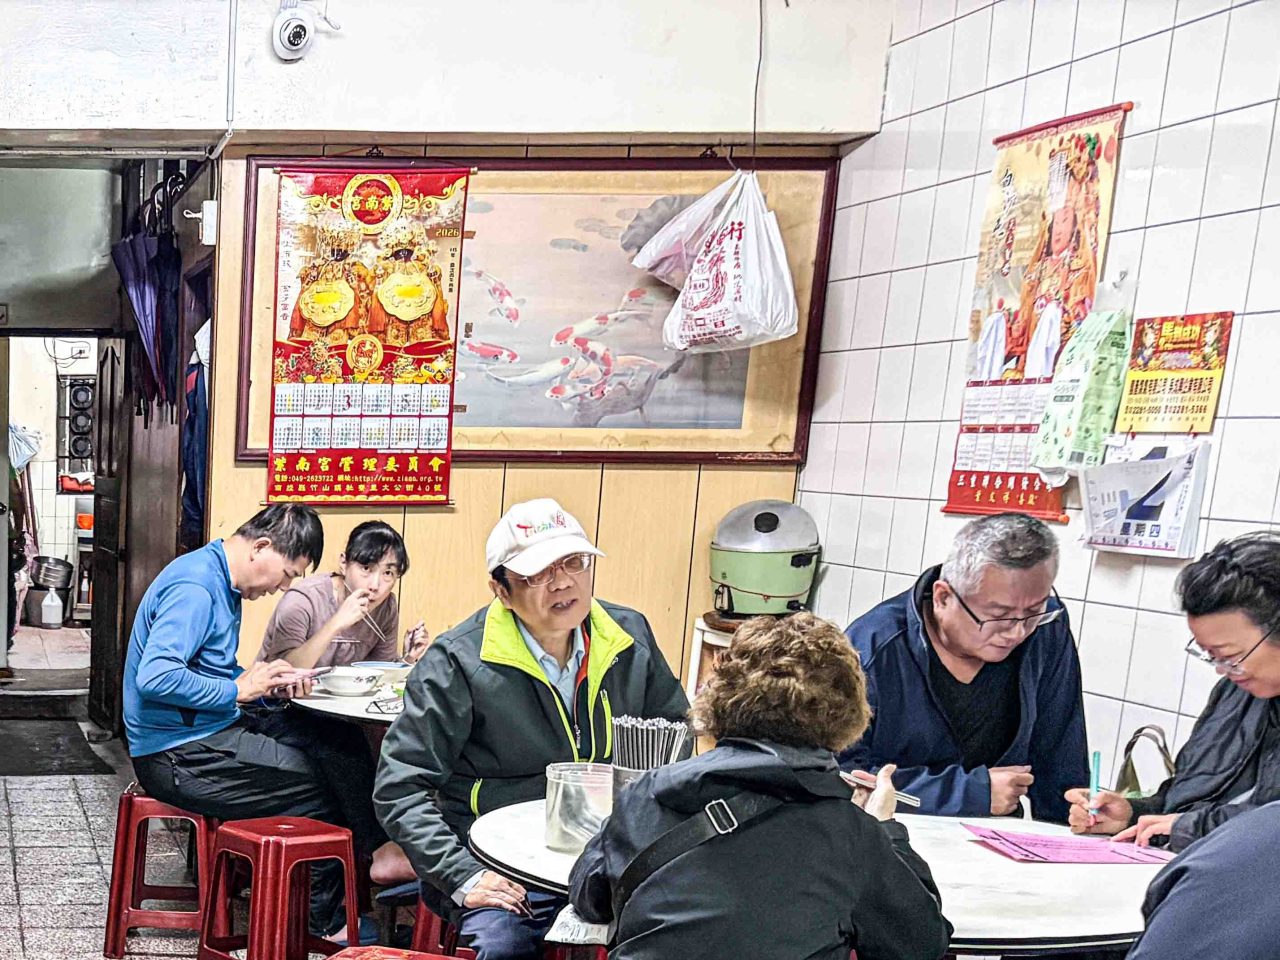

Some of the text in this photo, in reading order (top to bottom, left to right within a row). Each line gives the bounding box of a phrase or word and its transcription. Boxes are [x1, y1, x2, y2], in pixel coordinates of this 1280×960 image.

[435, 228, 460, 238] 2026
[274, 456, 446, 472] 紫南宮管理委員會
